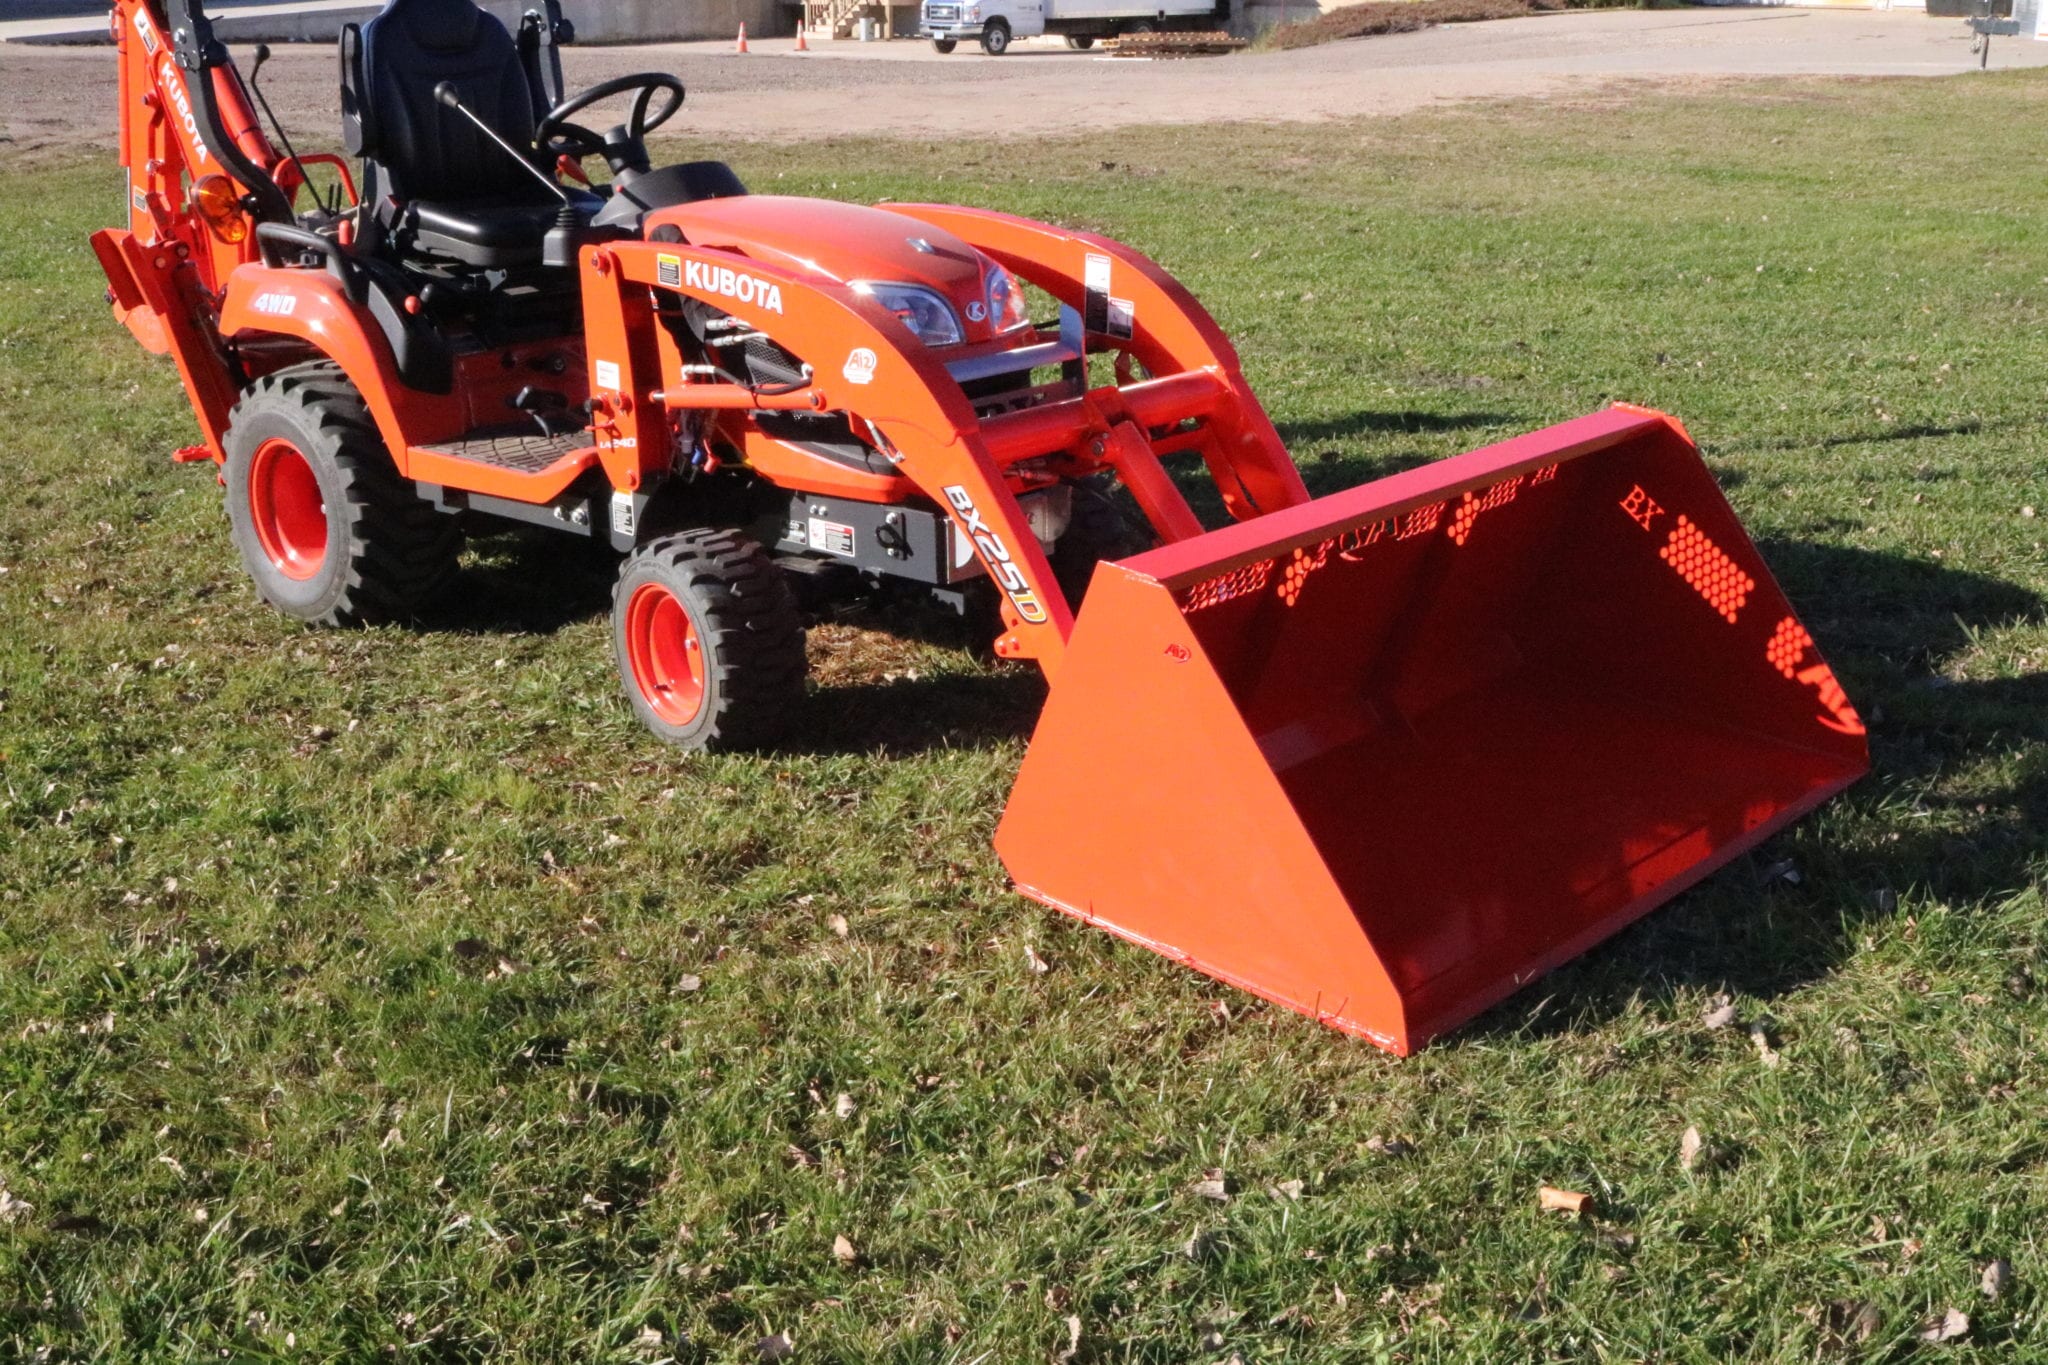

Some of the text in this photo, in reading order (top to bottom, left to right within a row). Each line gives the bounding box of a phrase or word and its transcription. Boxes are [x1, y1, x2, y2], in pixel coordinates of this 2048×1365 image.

[161, 62, 208, 163] KUBOTA
[254, 294, 296, 315] 4WD
[685, 259, 783, 315] KUBOTA
[599, 437, 637, 449] LA240
[1618, 484, 1665, 532] BX
[943, 485, 1047, 623] BX25D
